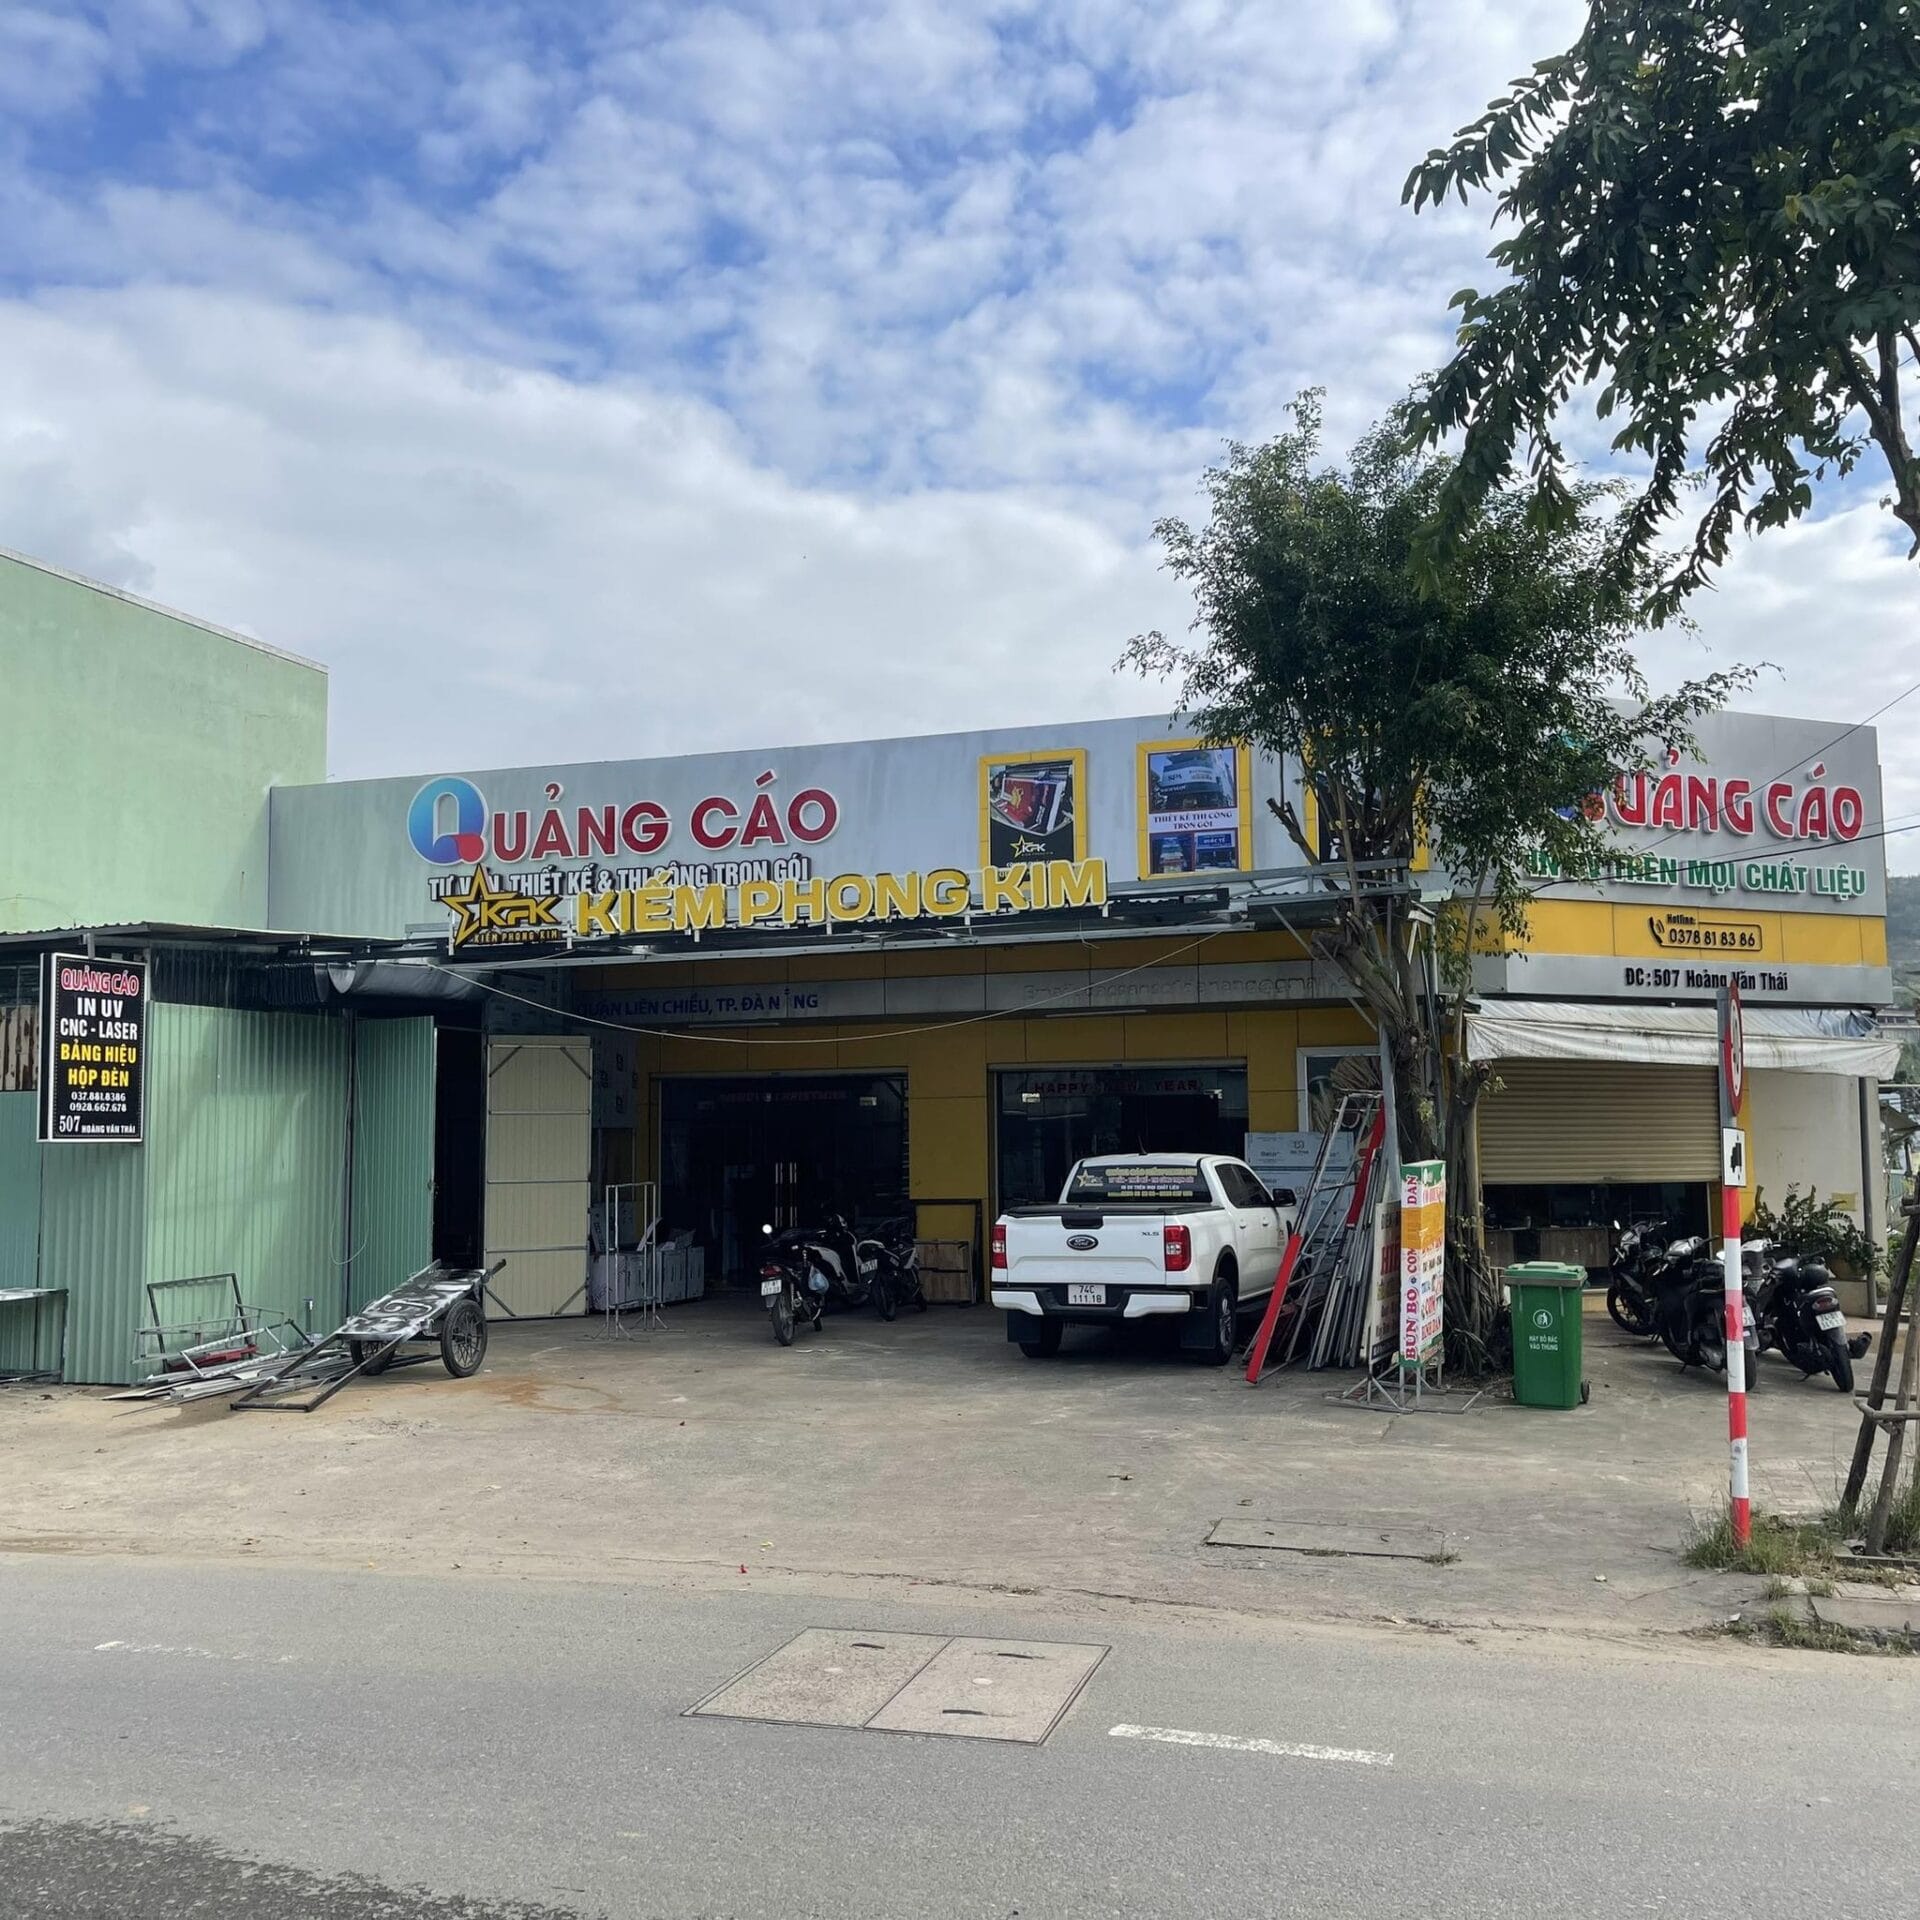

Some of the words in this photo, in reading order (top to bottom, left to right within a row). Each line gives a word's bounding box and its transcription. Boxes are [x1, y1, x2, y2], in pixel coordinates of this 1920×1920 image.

[1766, 763, 1864, 841] CÁO
[407, 776, 672, 866] QUẢNG
[690, 769, 840, 851] CÁO
[459, 867, 502, 896] VN
[567, 862, 598, 895] KẾ
[599, 870, 613, 892] &
[1686, 859, 1737, 895] MỌI
[1744, 856, 1809, 894] CHẤT
[1815, 864, 1867, 901] LIỆU
[577, 870, 729, 936] KIẾM
[737, 867, 970, 928] PHONG
[982, 857, 1109, 914] KIM
[1669, 928, 1701, 944] 0378
[1704, 930, 1718, 946] 81
[1720, 931, 1736, 946] 83
[1739, 932, 1756, 947] 86
[61, 965, 111, 994] QUẢNG
[1759, 971, 1789, 991] Thái
[77, 997, 97, 1016] IN
[101, 999, 124, 1018] UV
[60, 1018, 88, 1037] CNC
[99, 1021, 138, 1041] LASER
[60, 1039, 102, 1062] BẢNG
[105, 1043, 137, 1066] HIỆU
[68, 1066, 98, 1089] HỘP
[59, 1114, 81, 1134] 507
[1073, 1238, 1090, 1248] Ford
